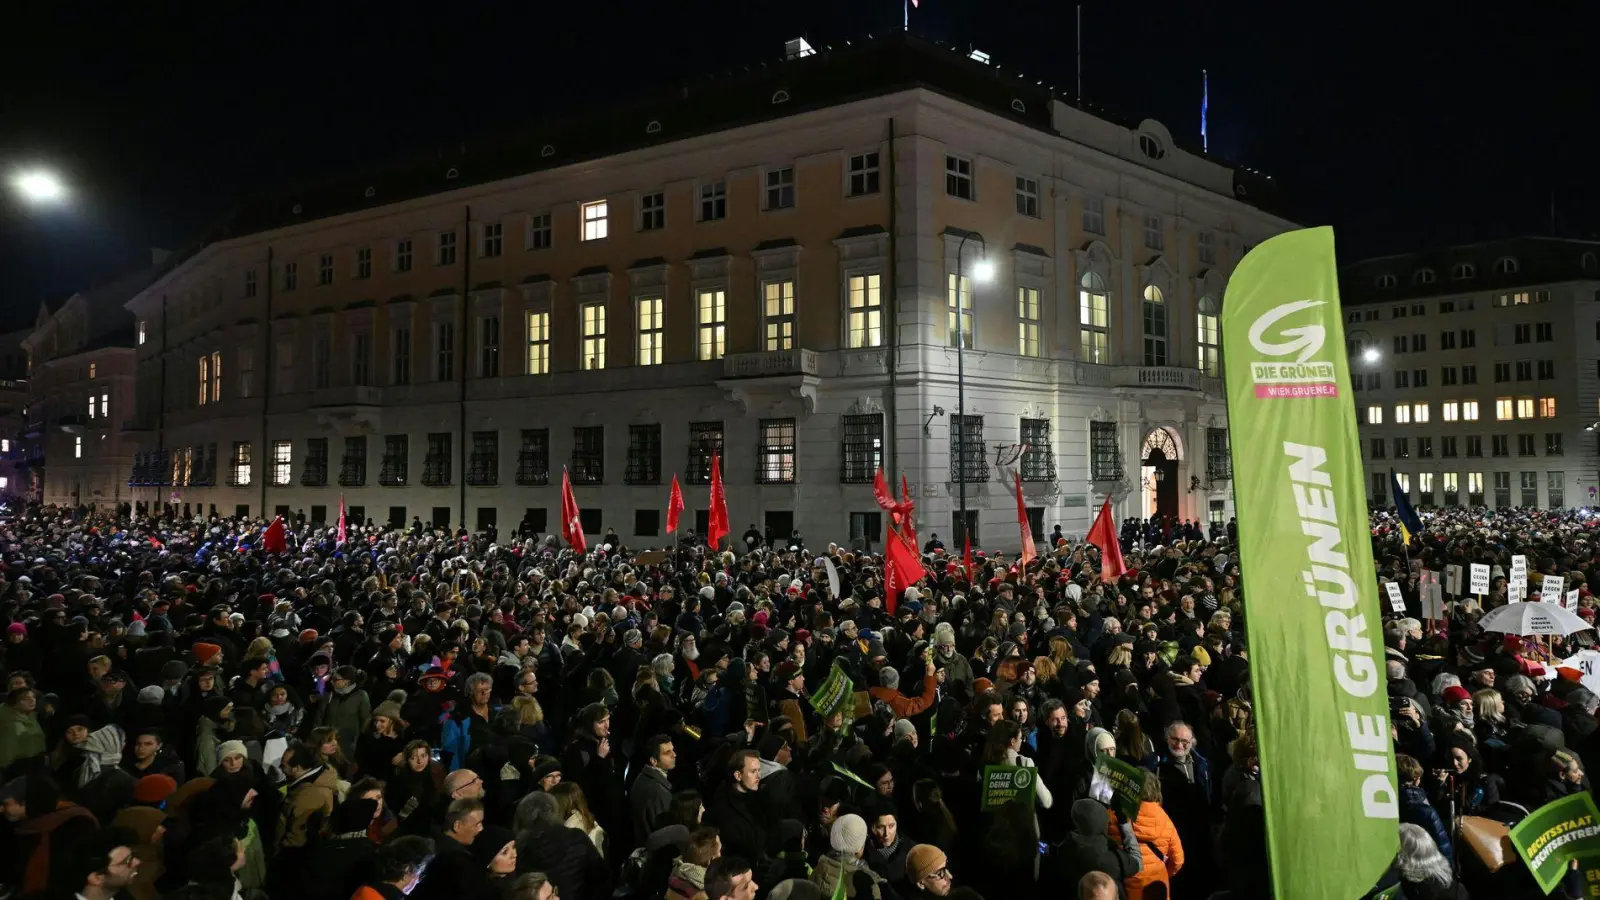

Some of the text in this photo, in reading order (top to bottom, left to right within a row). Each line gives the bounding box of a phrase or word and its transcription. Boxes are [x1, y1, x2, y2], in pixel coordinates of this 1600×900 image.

[1255, 364, 1333, 379] DIE GRÜNEN
[1283, 440, 1399, 819] DIE GRÜNEN
[990, 772, 1012, 780] HALTE
[989, 780, 1011, 788] DEINE
[989, 789, 1018, 797] UMWELT
[1527, 815, 1592, 859] RECHTSSTAAT
